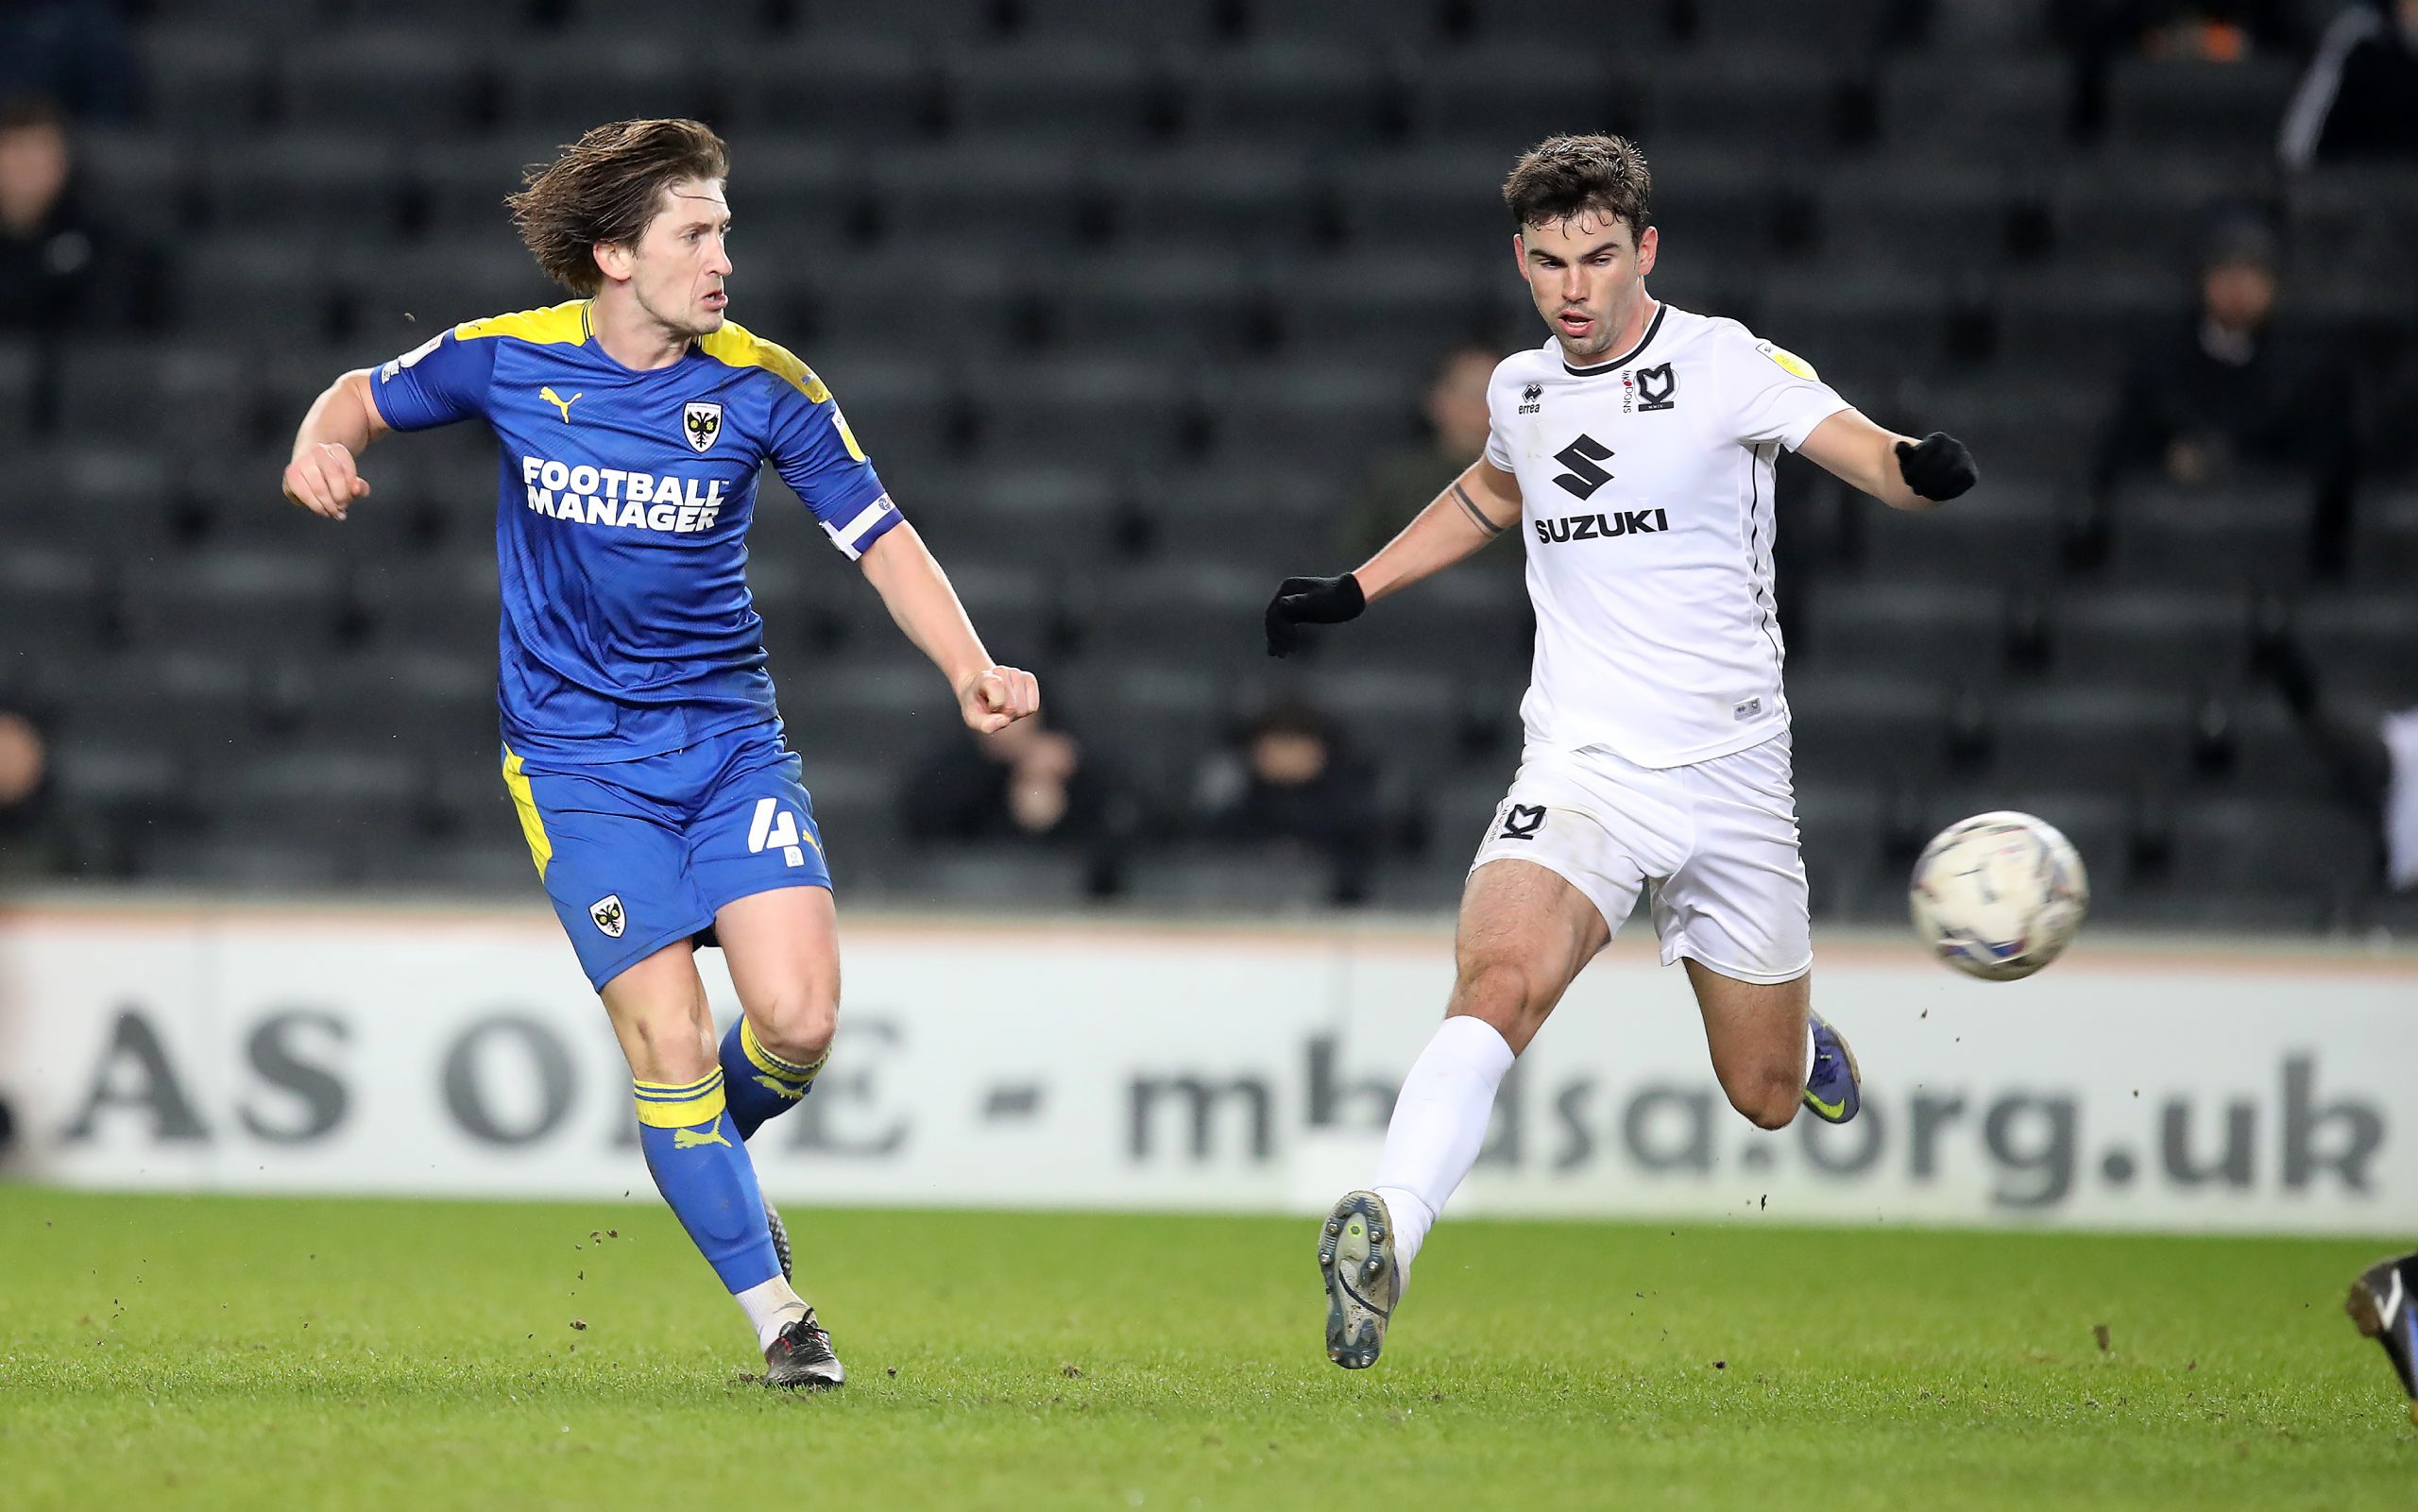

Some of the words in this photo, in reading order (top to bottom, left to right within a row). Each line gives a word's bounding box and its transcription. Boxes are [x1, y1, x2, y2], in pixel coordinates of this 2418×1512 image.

[1623, 386, 1634, 414] DONS
[522, 455, 725, 507] FOOTBALL
[527, 484, 720, 533] MANAGER
[1535, 508, 1669, 545] SUZUKI
[747, 797, 805, 868] 4
[66, 1005, 351, 1141] AS
[440, 1009, 909, 1158] OE
